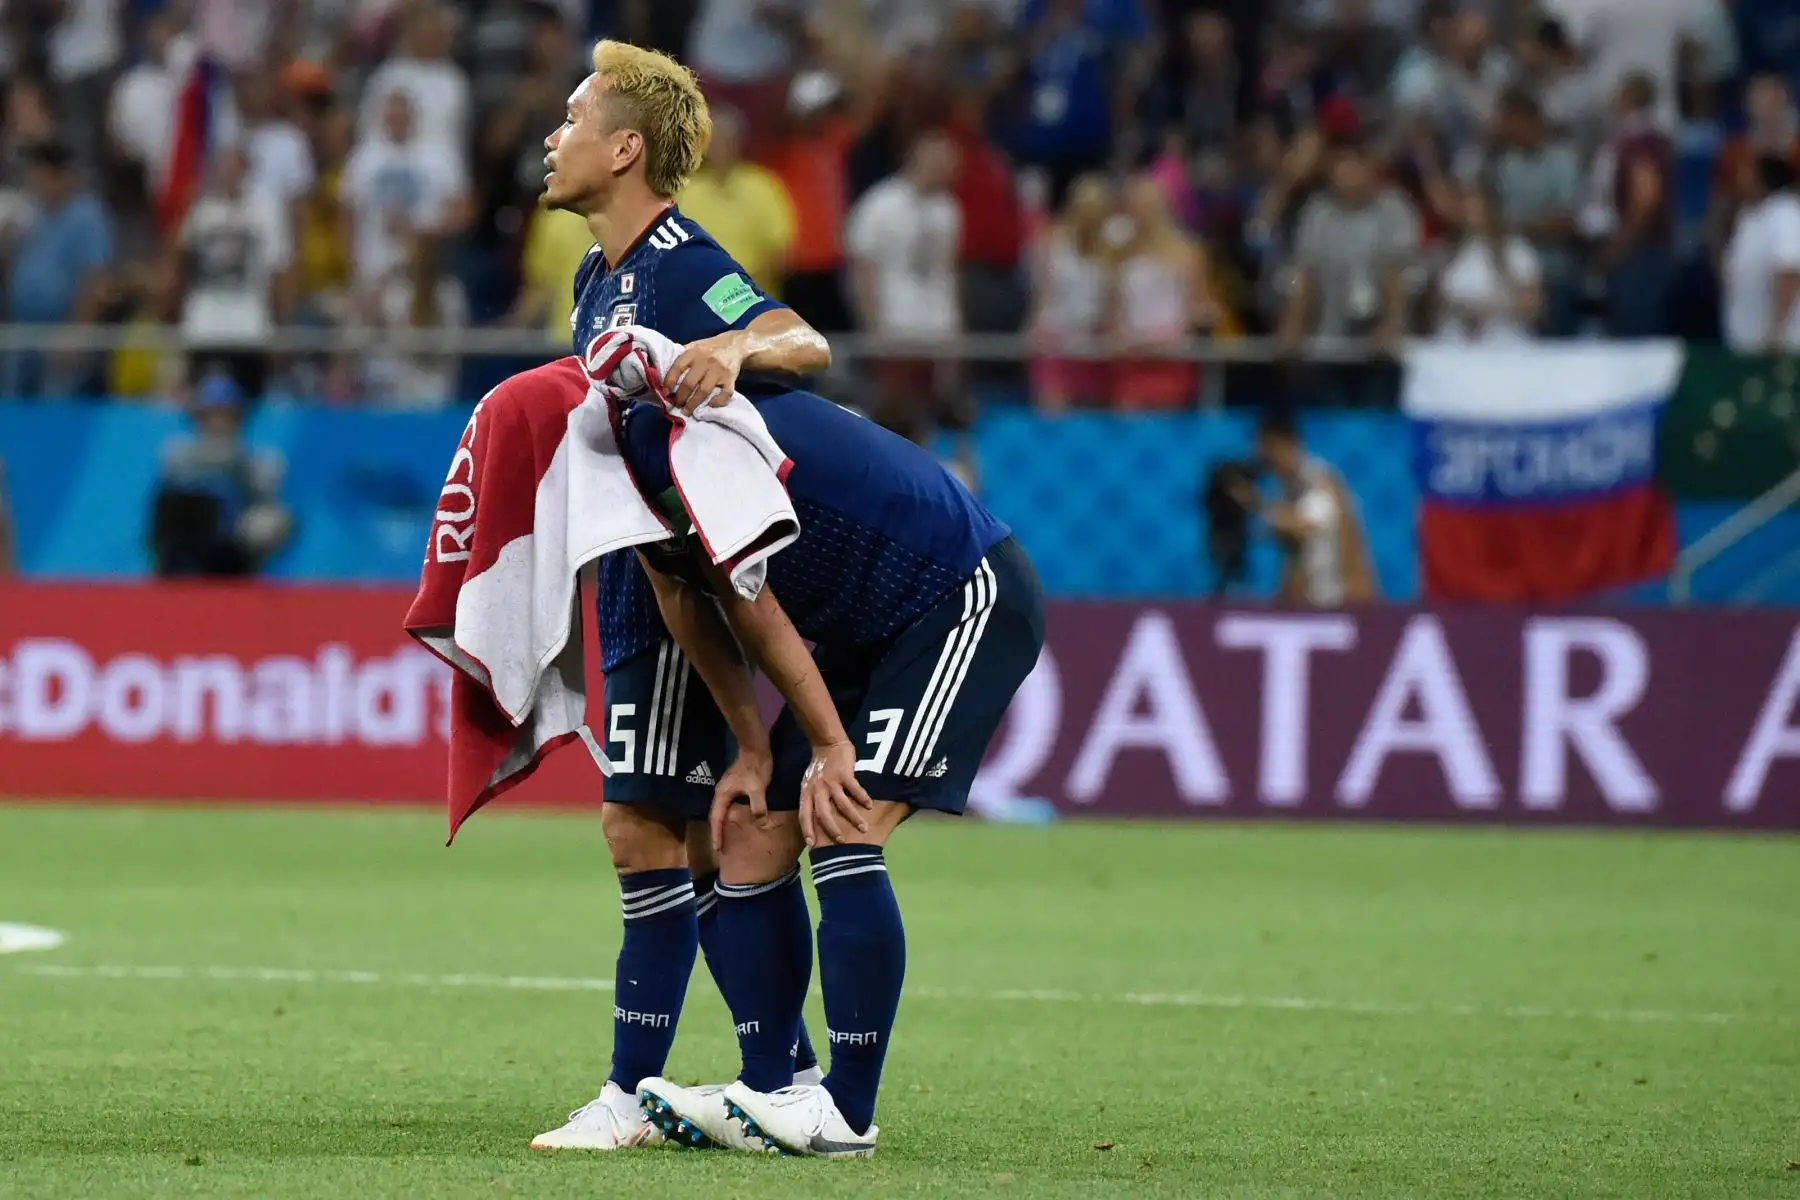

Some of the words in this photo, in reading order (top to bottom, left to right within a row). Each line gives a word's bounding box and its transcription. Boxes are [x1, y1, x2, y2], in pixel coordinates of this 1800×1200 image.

[609, 703, 636, 774] 5
[854, 708, 905, 774] 3
[827, 1027, 878, 1046] APAN
